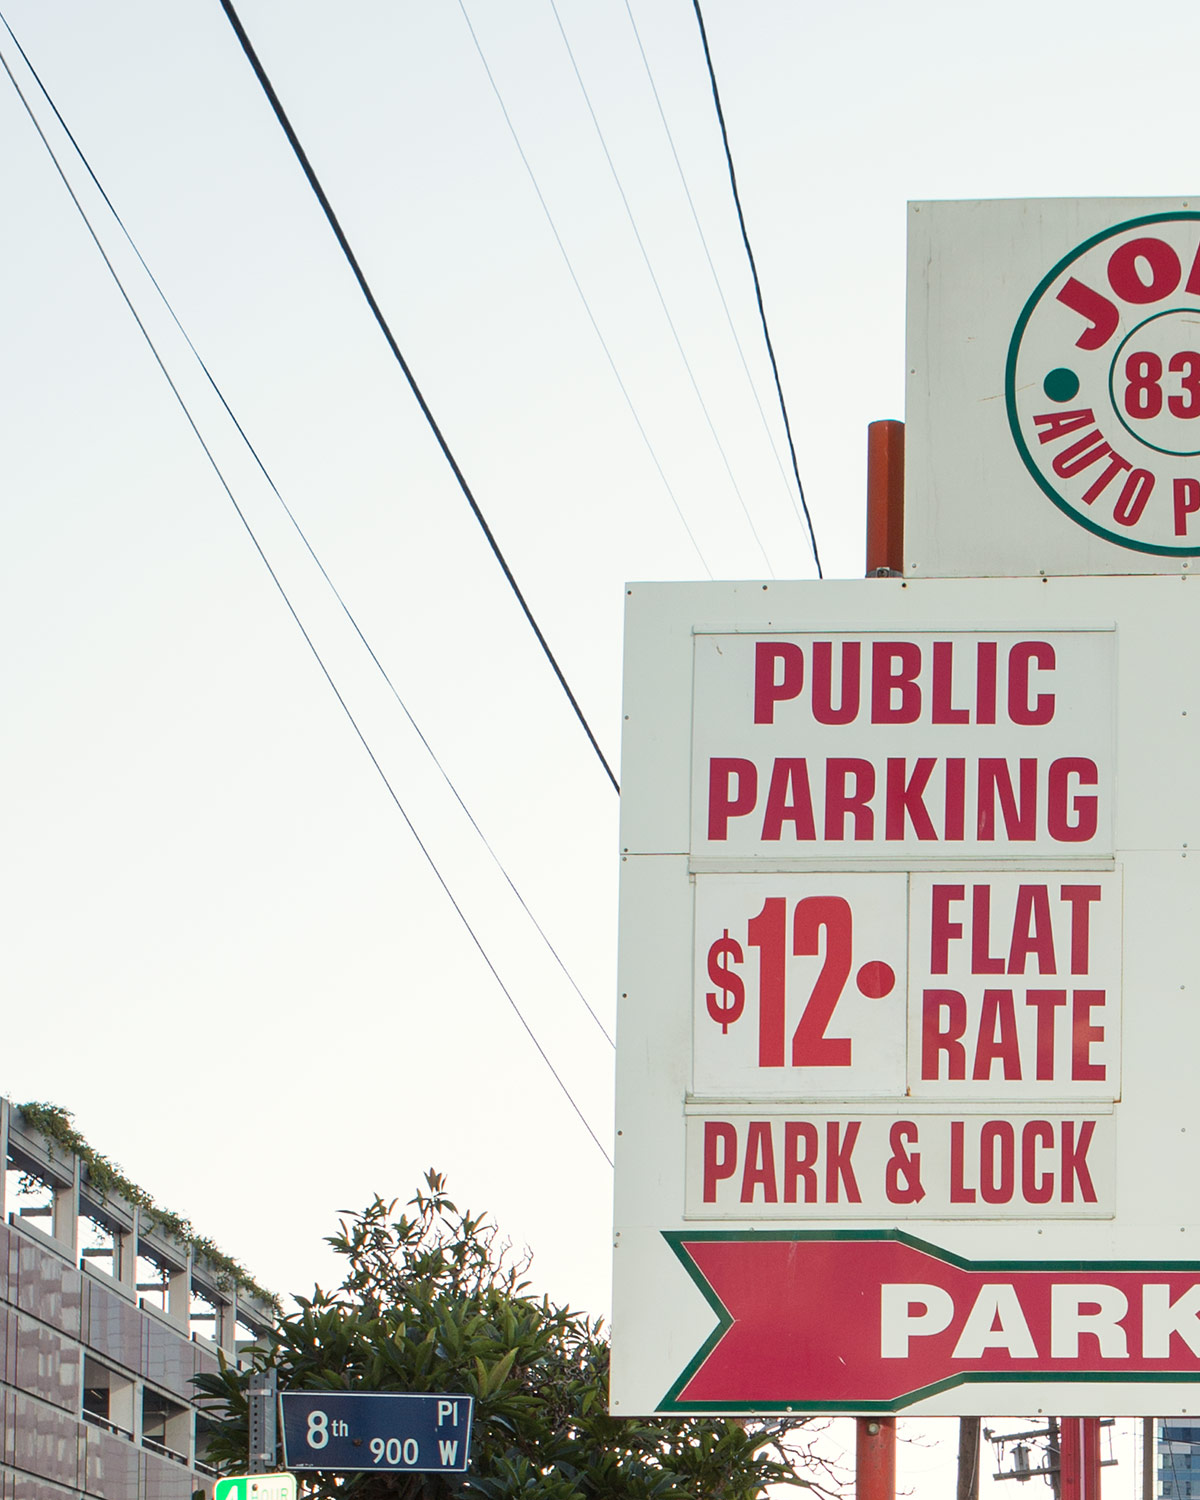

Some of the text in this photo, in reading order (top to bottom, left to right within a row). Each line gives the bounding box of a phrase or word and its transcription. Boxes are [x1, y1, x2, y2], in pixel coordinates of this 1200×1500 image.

[1032, 408, 1156, 527] AUTO
[755, 642, 1056, 727] PUBLIC
[708, 756, 1099, 843] PARKING
[930, 884, 1102, 976] FLAT
[921, 989, 1107, 1082] RATE
[703, 1120, 1098, 1205] PARK & LOCK
[306, 1410, 350, 1450] 8th
[369, 1437, 459, 1467] 900 W
